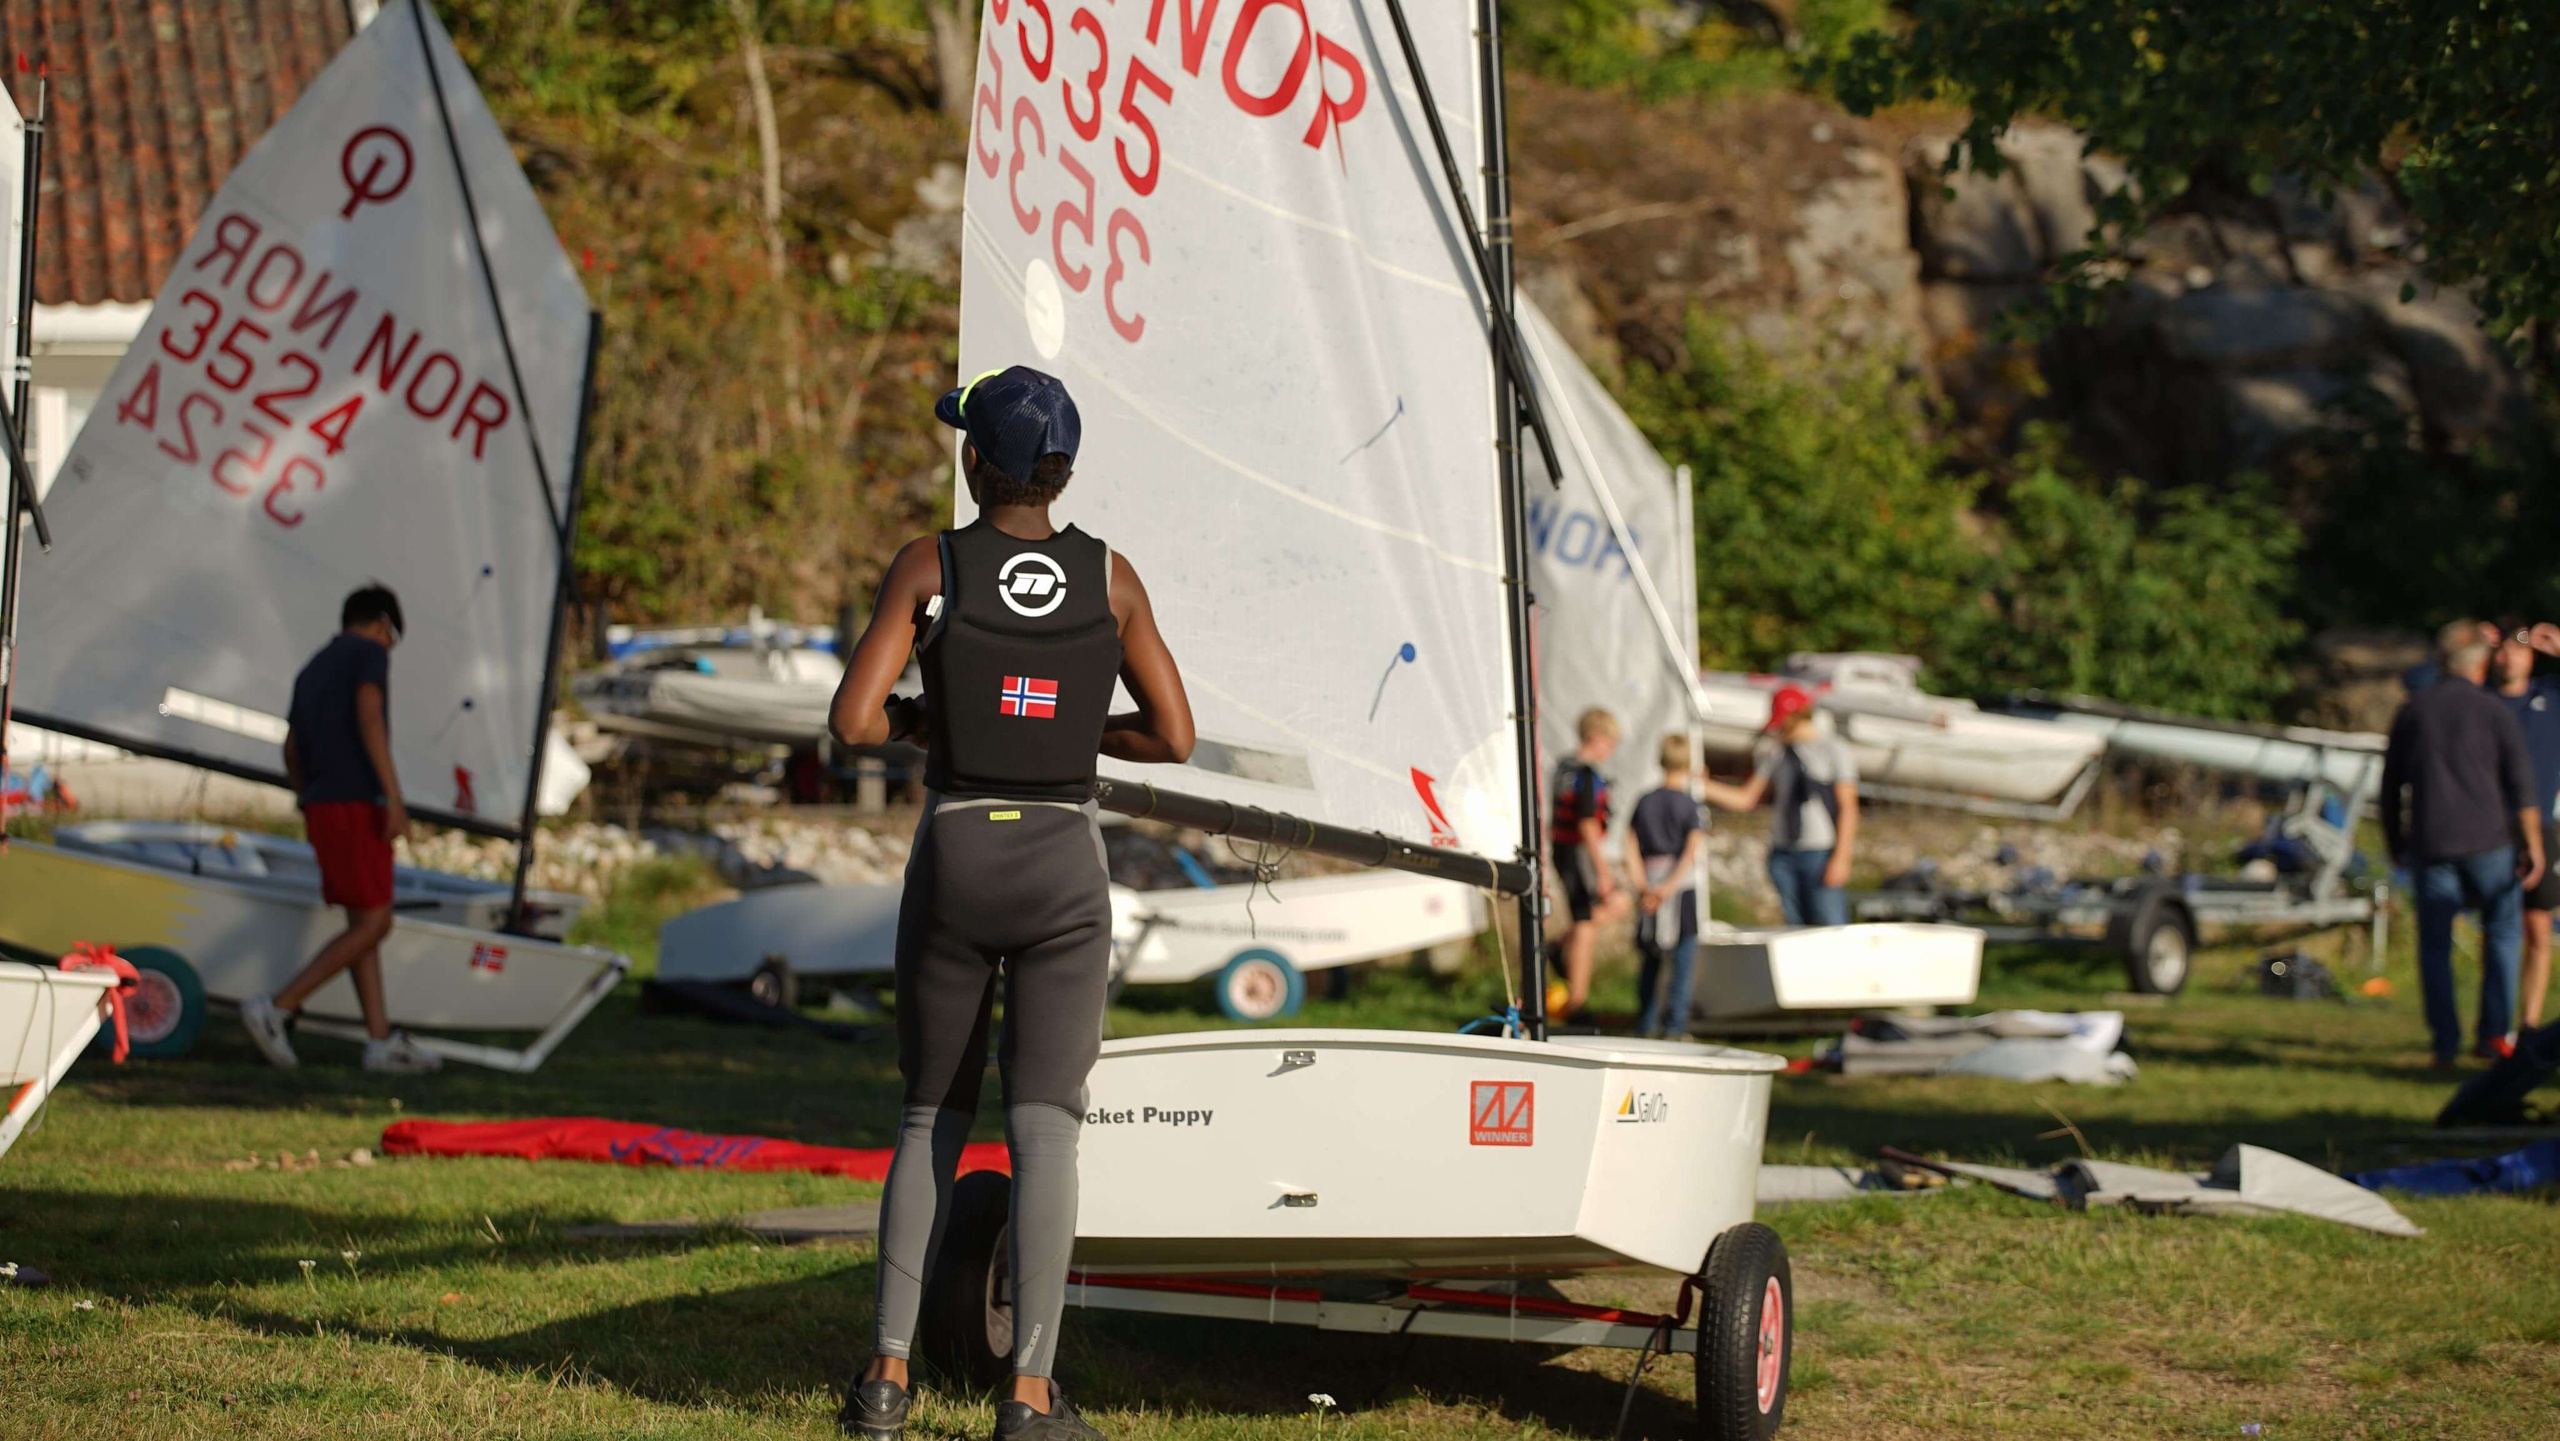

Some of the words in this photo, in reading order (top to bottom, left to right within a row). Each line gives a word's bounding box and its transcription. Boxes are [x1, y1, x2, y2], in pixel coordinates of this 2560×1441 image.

[992, 0, 1174, 197] 535
[160, 290, 365, 456] 3524
[354, 311, 511, 461] NOR
[1142, 1106, 1213, 1126] Puppy
[1474, 1131, 1529, 1143] WINNER
